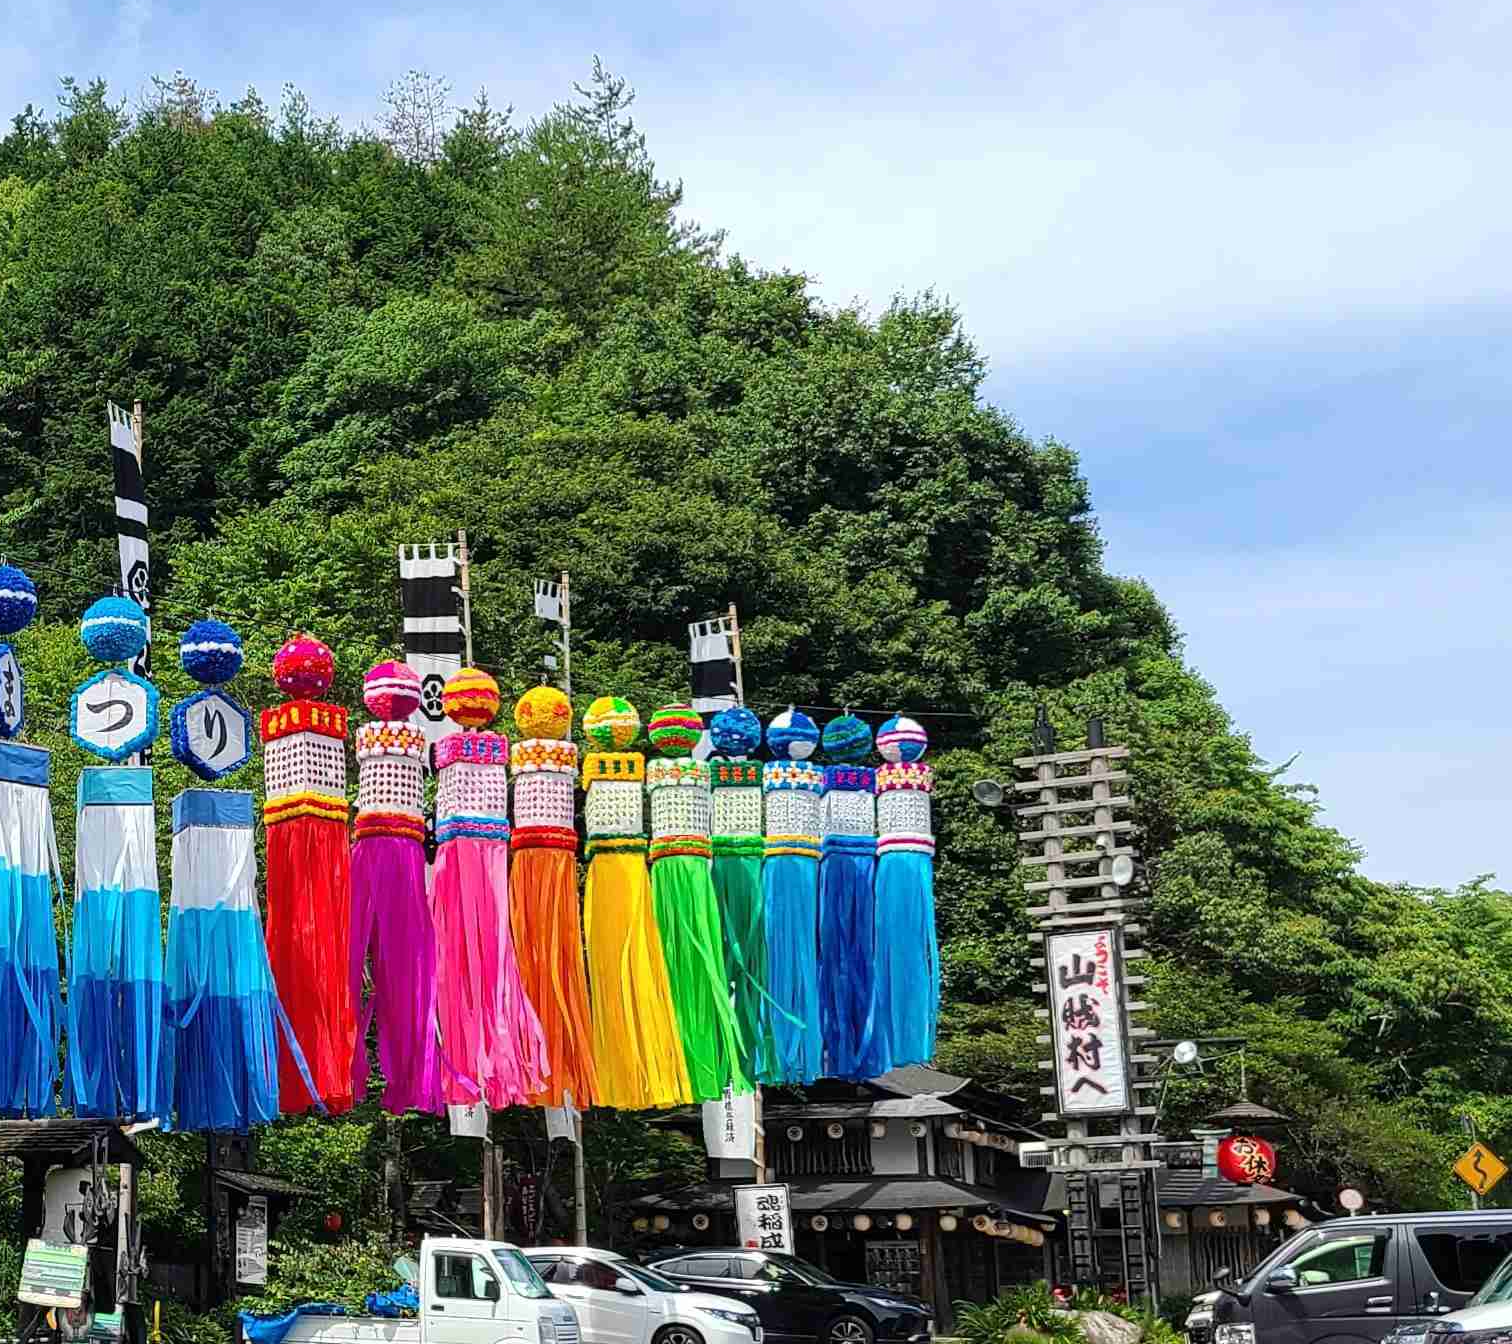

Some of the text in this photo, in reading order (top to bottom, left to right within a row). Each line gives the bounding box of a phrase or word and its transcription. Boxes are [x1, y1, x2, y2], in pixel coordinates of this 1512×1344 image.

[85, 699, 135, 733] つ
[203, 705, 228, 760] り
[1058, 953, 1108, 1095] 山賊村へ
